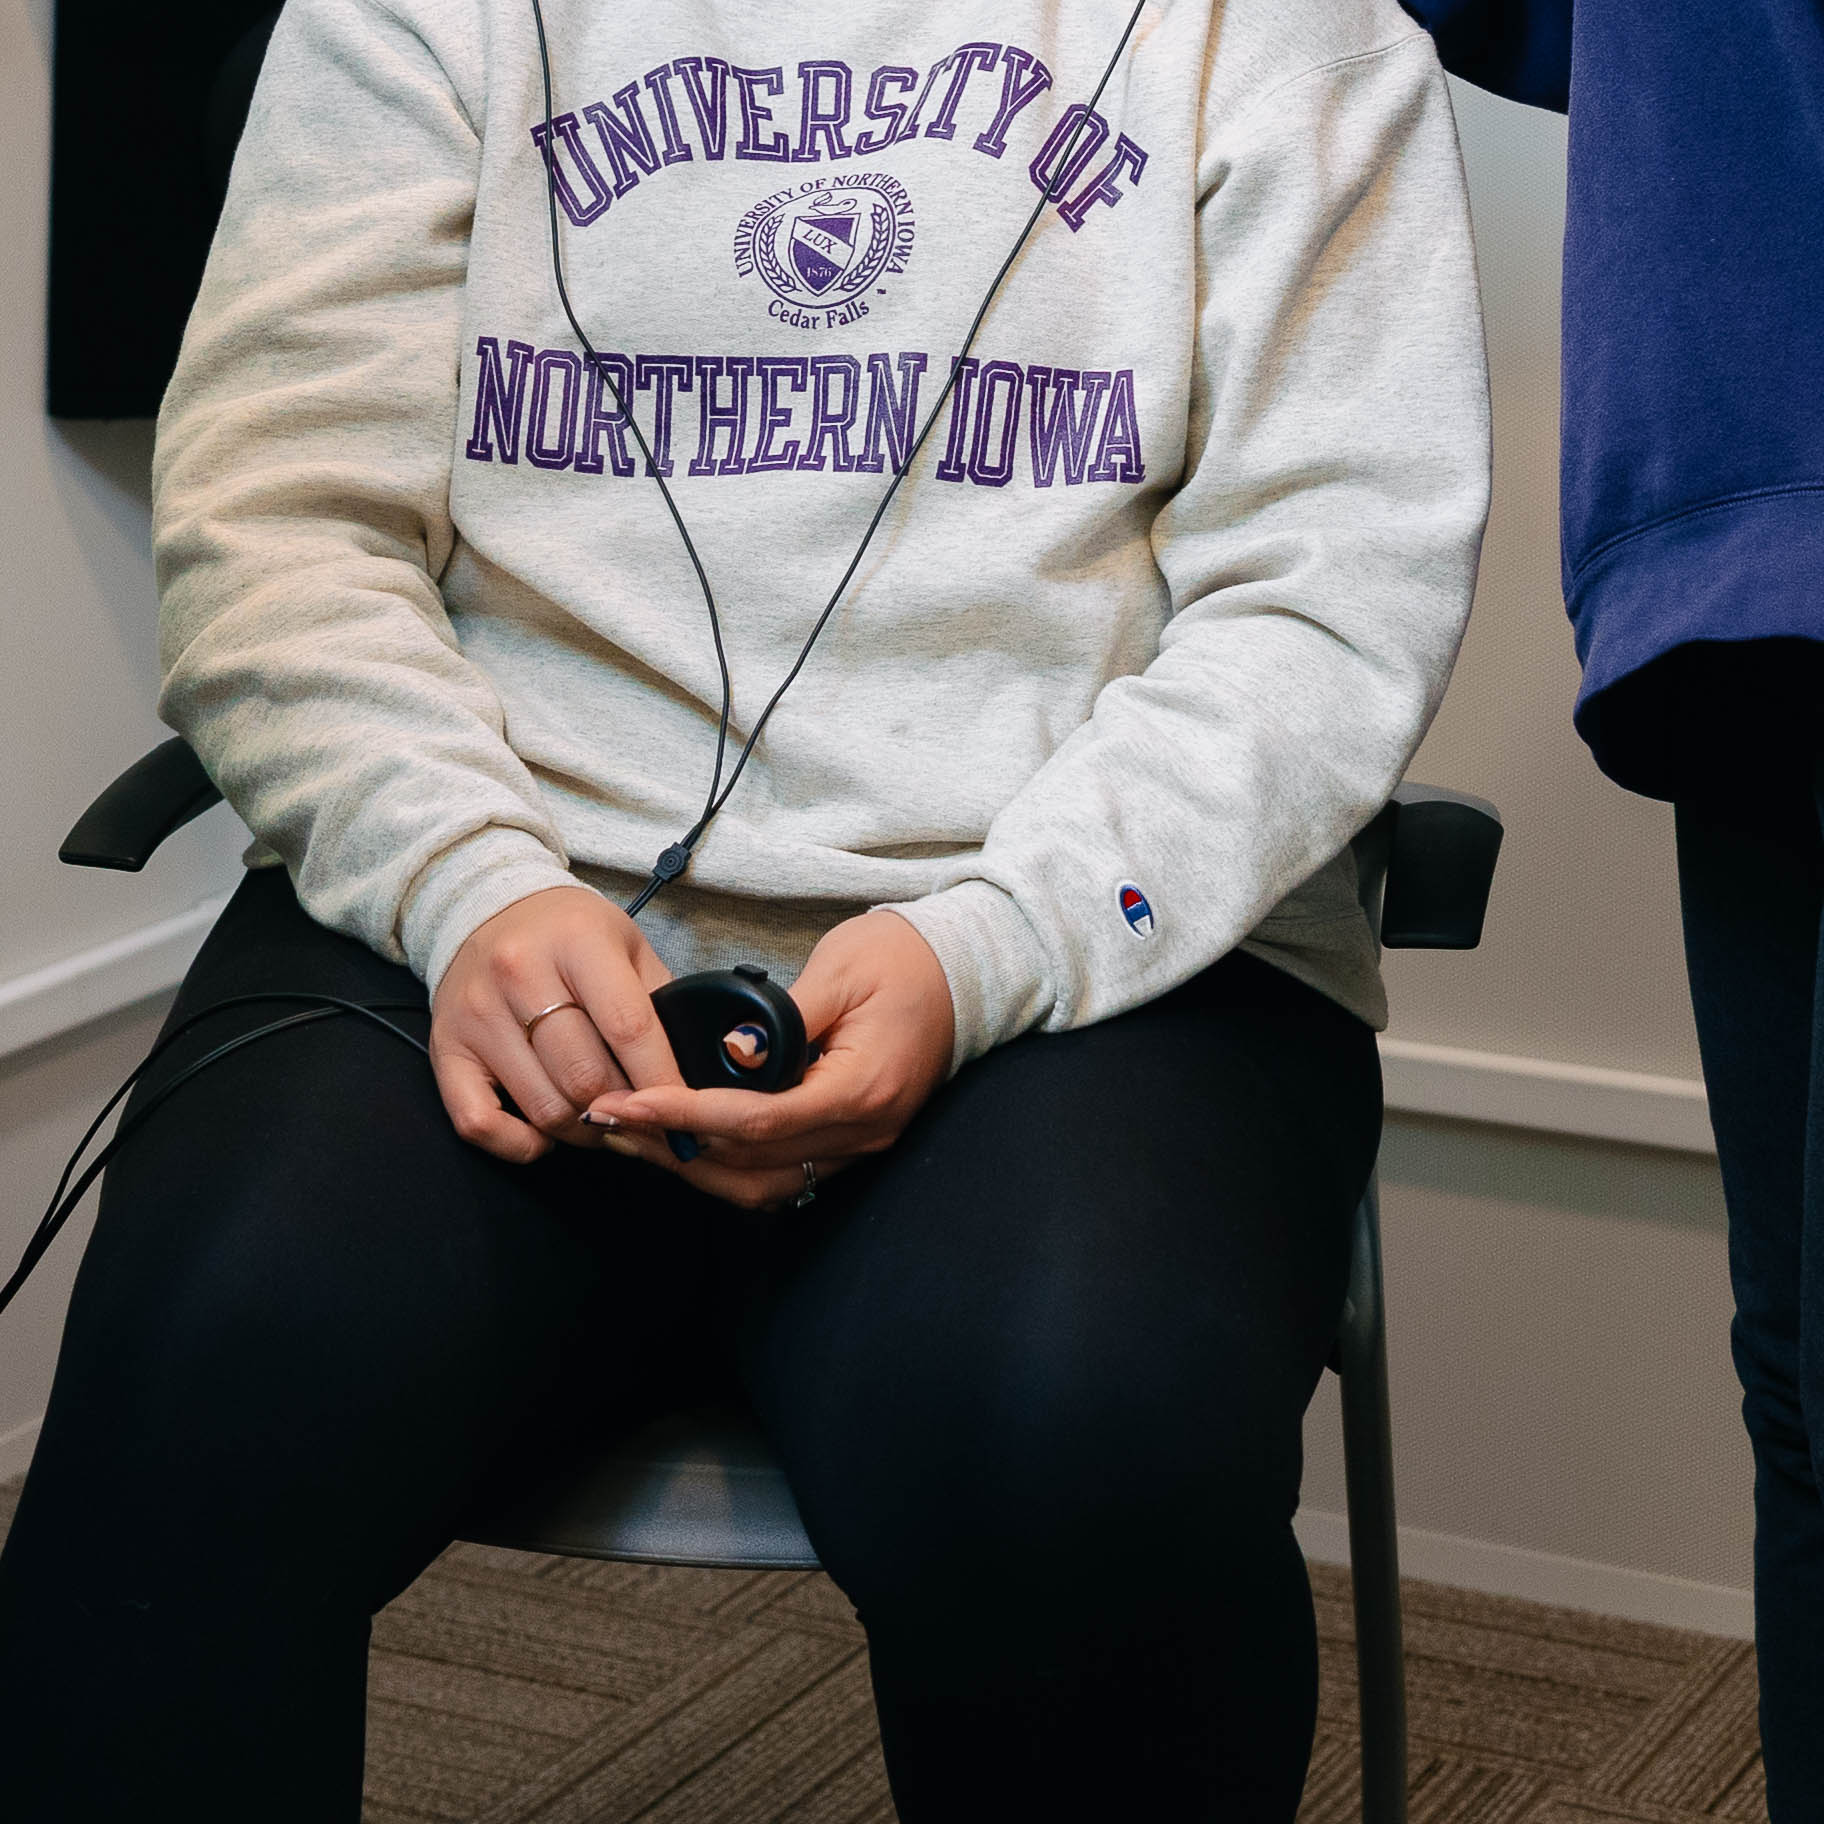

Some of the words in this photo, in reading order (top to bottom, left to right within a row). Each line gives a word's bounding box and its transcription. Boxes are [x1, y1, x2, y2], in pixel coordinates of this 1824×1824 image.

[531, 42, 1053, 228] UNIVERSITY
[1028, 103, 1149, 233] OF
[734, 188, 794, 278] UNIVERSITY
[800, 178, 826, 192] OF
[832, 173, 914, 215] NORTHERN
[885, 220, 916, 275] IOWA
[802, 229, 838, 254] LUX
[806, 266, 832, 278] 1876
[768, 299, 820, 329] Cedar
[826, 300, 870, 329] Falls
[465, 336, 928, 478] NORTHERN
[936, 357, 1146, 489] IOWA
